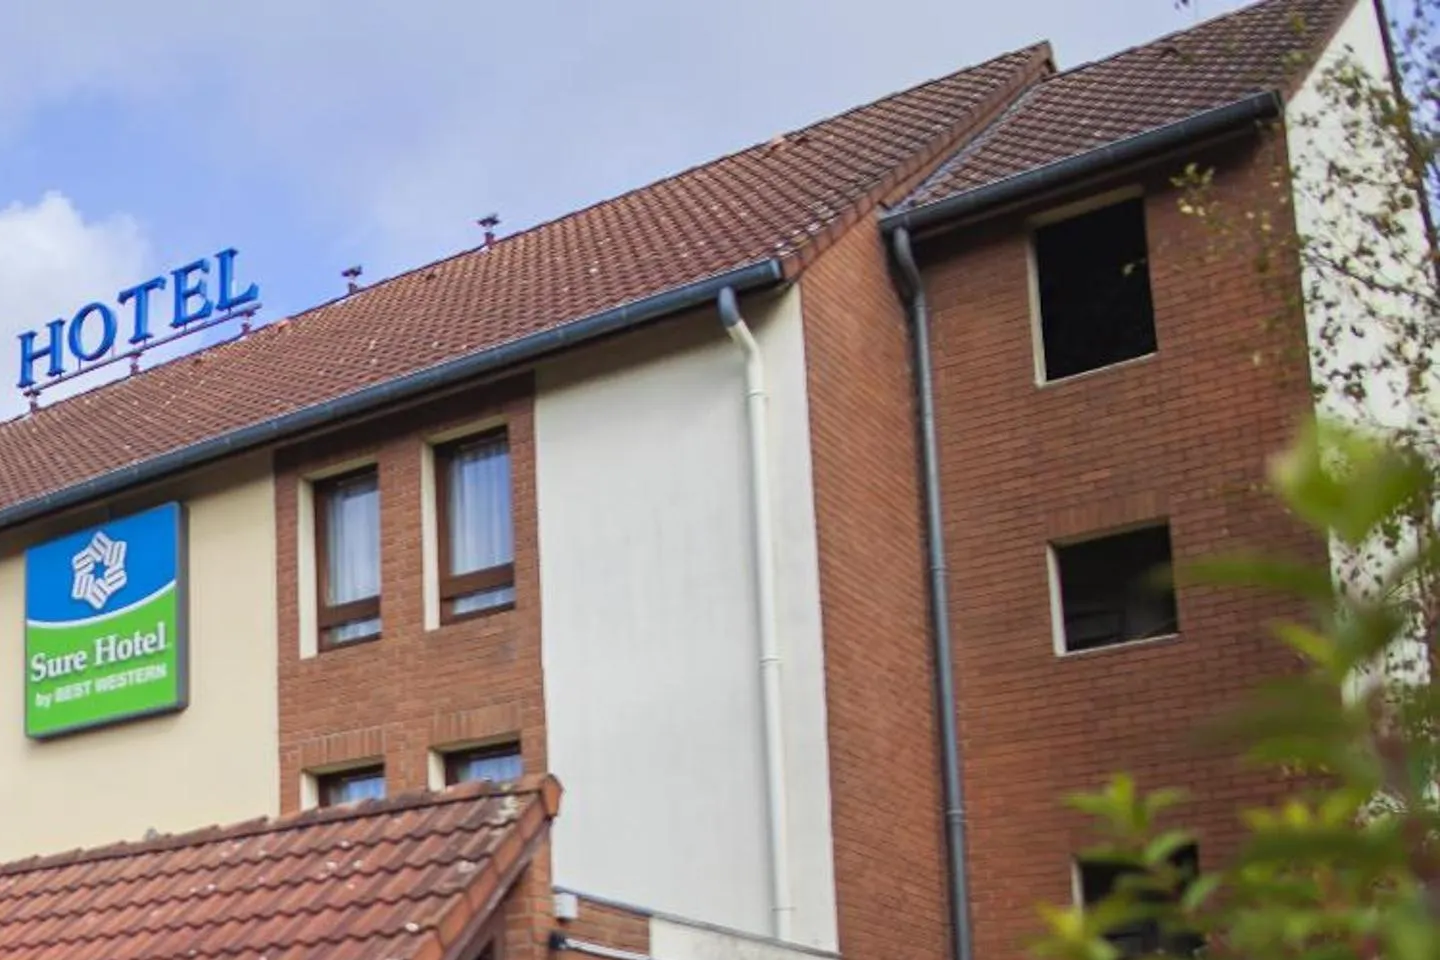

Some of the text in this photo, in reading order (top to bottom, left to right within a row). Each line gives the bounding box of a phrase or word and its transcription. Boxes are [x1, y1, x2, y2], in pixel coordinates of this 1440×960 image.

[16, 248, 259, 388] HOTEL
[30, 621, 167, 682] Sure Hotel
[35, 663, 168, 710] by BEST WESTERN
